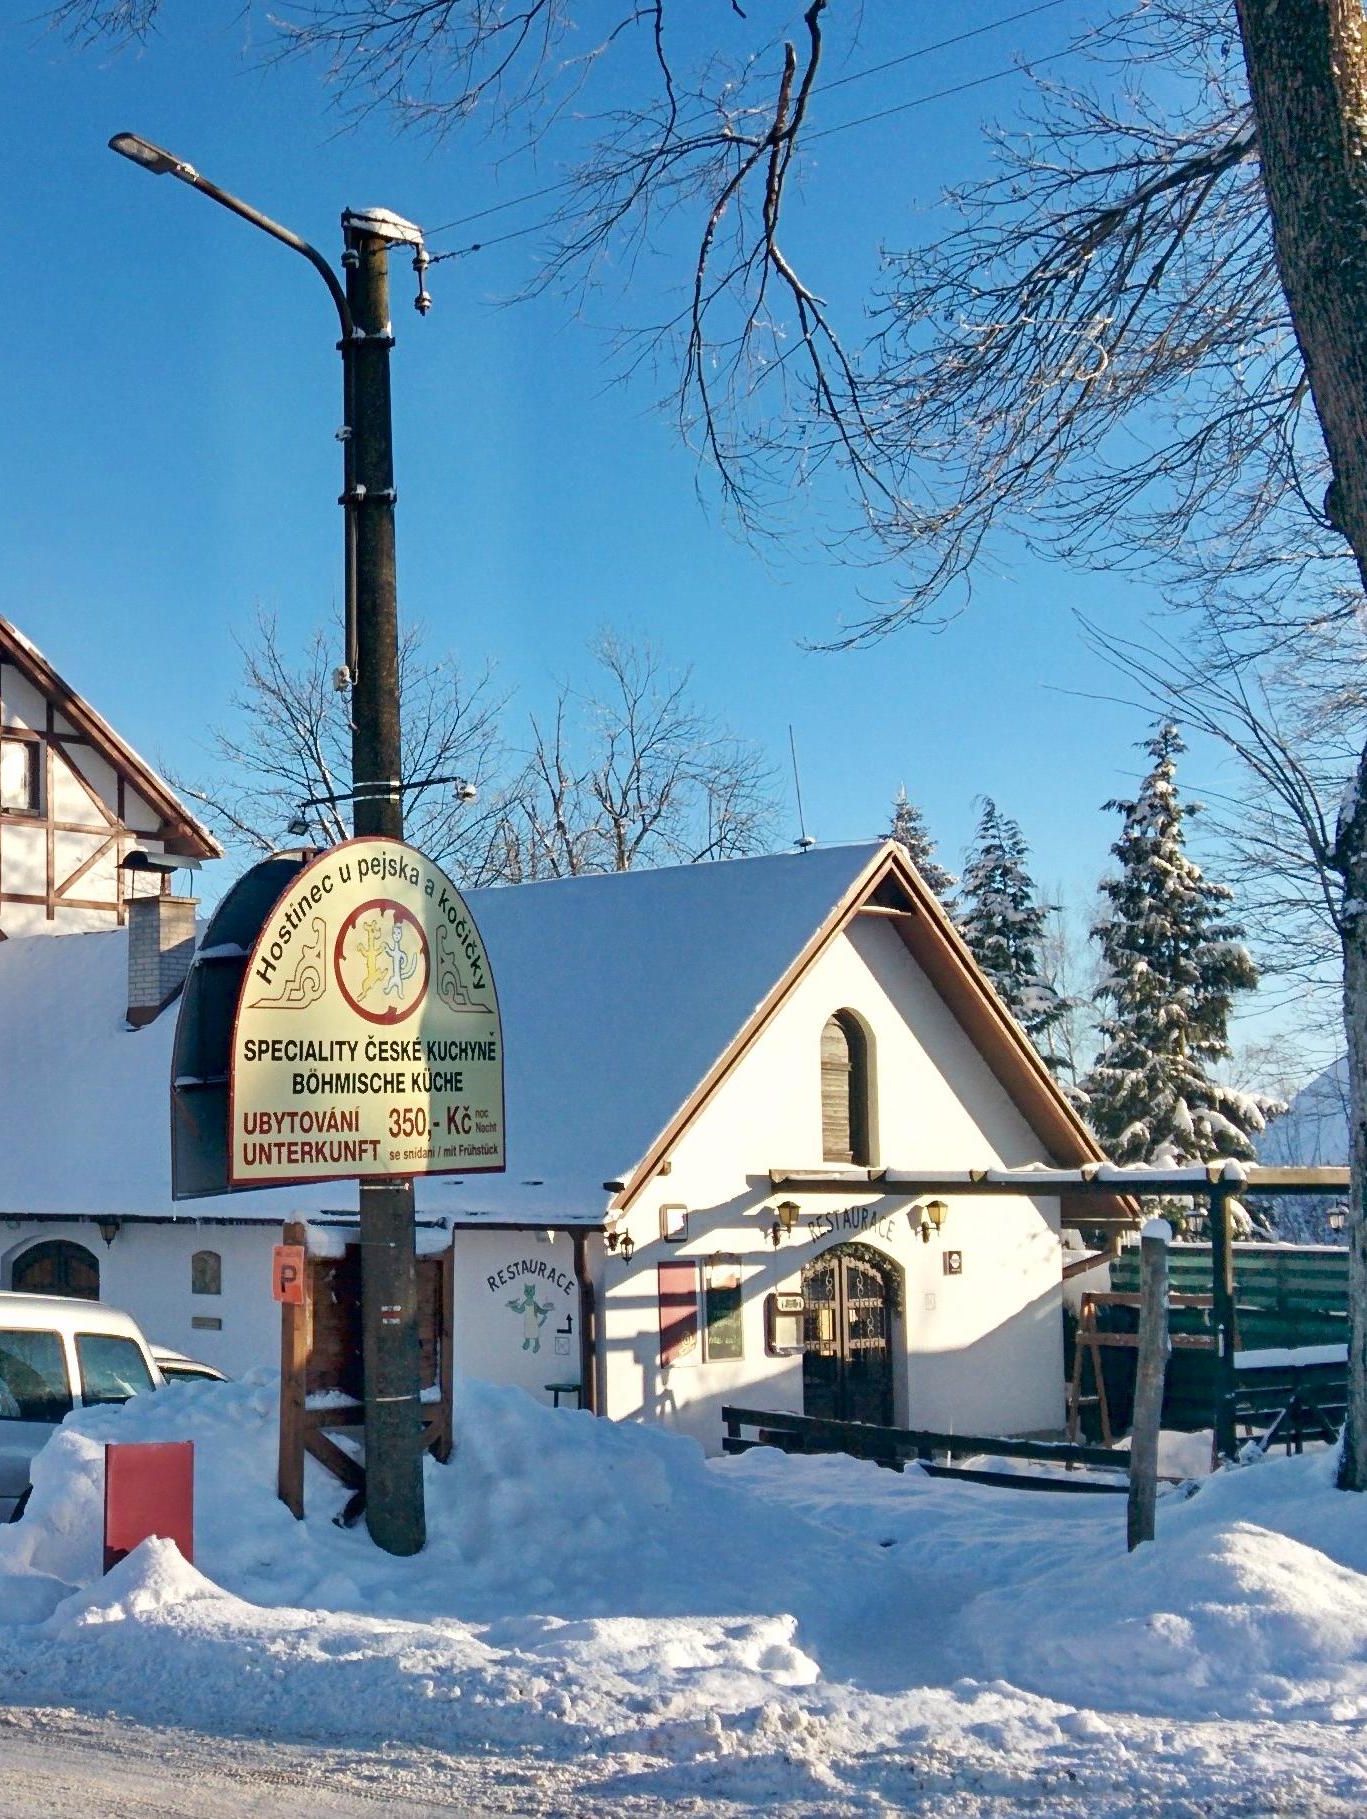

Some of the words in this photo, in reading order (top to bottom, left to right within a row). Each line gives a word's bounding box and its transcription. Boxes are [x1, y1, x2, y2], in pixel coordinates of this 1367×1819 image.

[256, 874, 334, 985] Hostinec
[339, 863, 352, 883] u
[357, 851, 420, 886] pejska
[425, 878, 435, 896] a
[437, 888, 486, 990] kočičky
[243, 1039, 359, 1062] SPECIALITY
[364, 1034, 422, 1062] ČESKÉ
[426, 1031, 497, 1062] KUCHYNĚ
[292, 1068, 406, 1095] BÖHMISCHE
[411, 1067, 463, 1093] KÜCHE
[243, 1105, 360, 1136] UBYTOVÁNÍ
[388, 1107, 440, 1143] 350,-
[446, 1104, 473, 1136] Kč
[475, 1108, 489, 1119] noc
[475, 1121, 498, 1134] Nacht
[243, 1139, 381, 1166] UNTERKUNFT
[389, 1149, 401, 1161] se
[443, 1145, 457, 1158] mit
[458, 1141, 499, 1156] Frühstück
[808, 1207, 895, 1244] RESTAURACE
[281, 1264, 297, 1293] P
[487, 1259, 575, 1296] RESTAURACE
